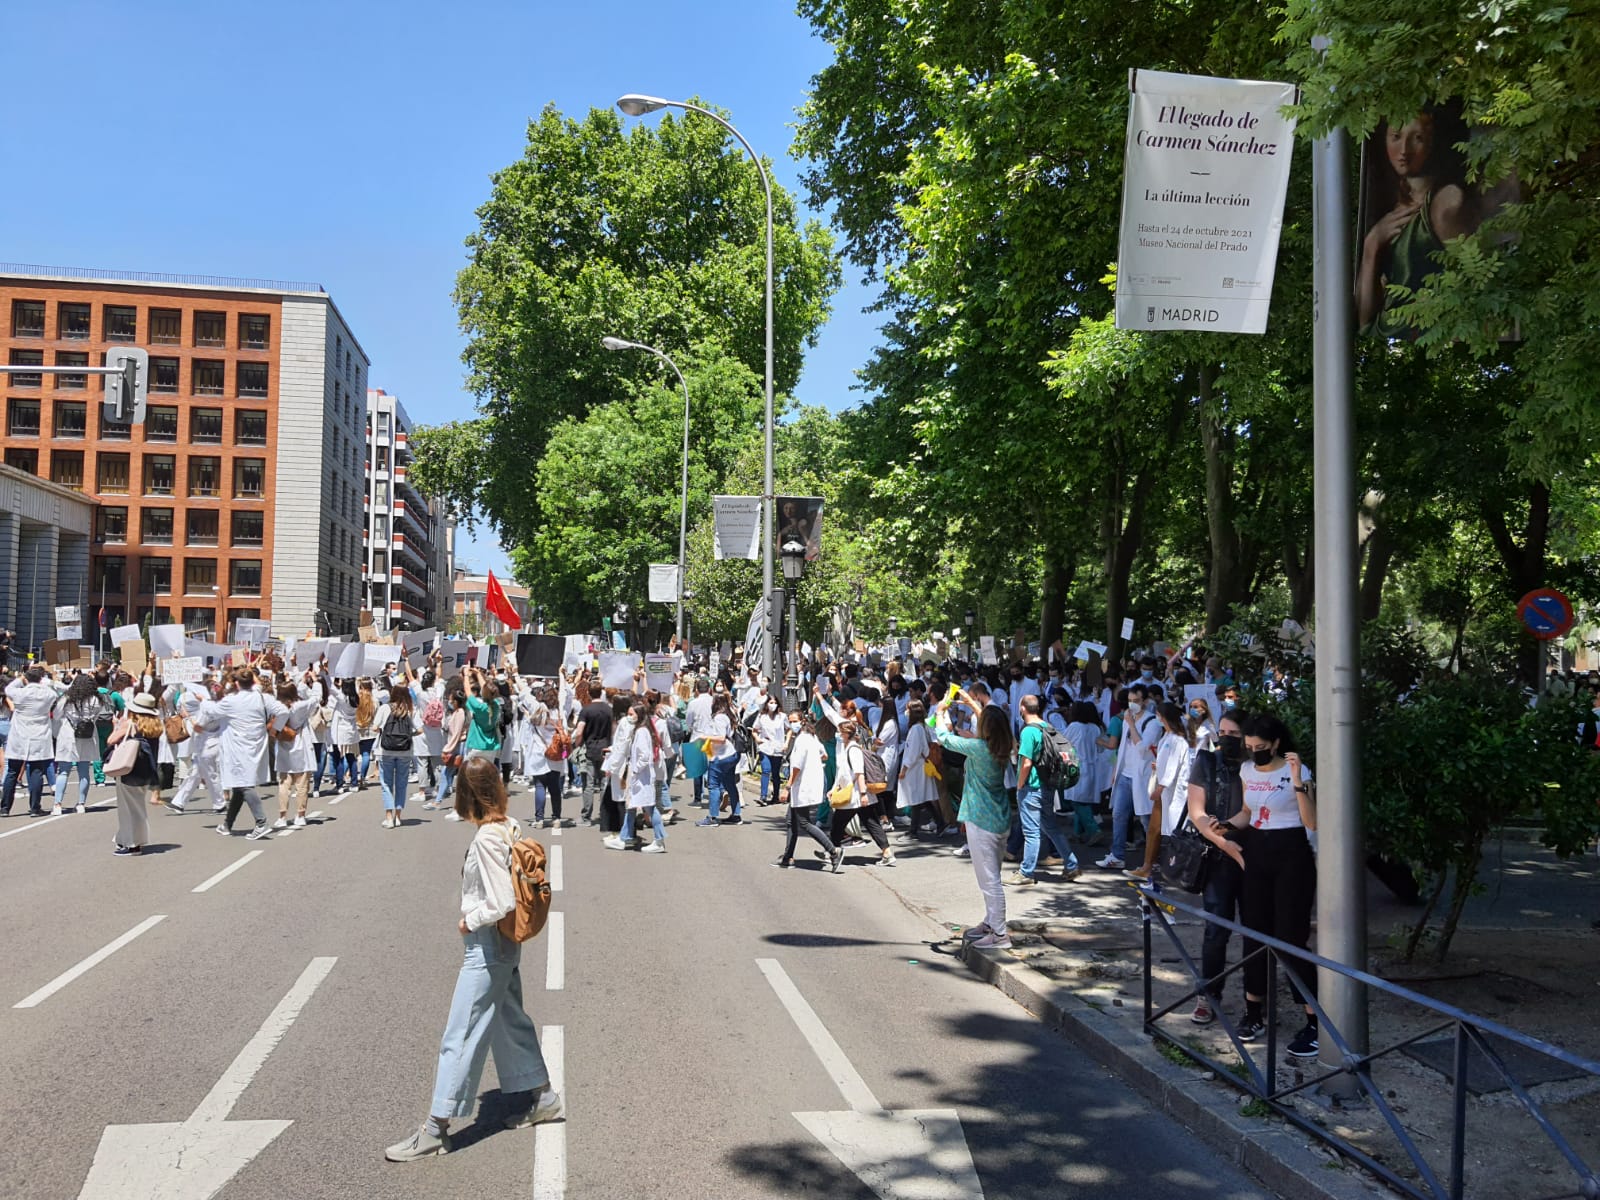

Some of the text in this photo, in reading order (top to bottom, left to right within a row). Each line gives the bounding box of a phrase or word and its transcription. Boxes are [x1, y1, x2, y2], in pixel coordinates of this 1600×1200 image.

[1158, 105, 1259, 130] El legado de
[1137, 129, 1277, 155] Carmen Sánchez
[1145, 189, 1250, 206] La última lección
[1138, 223, 1252, 238] Hasta el 24 de octubre 2021
[1139, 238, 1248, 251] Museo Nacional del Prado
[1162, 308, 1219, 322] MADRID
